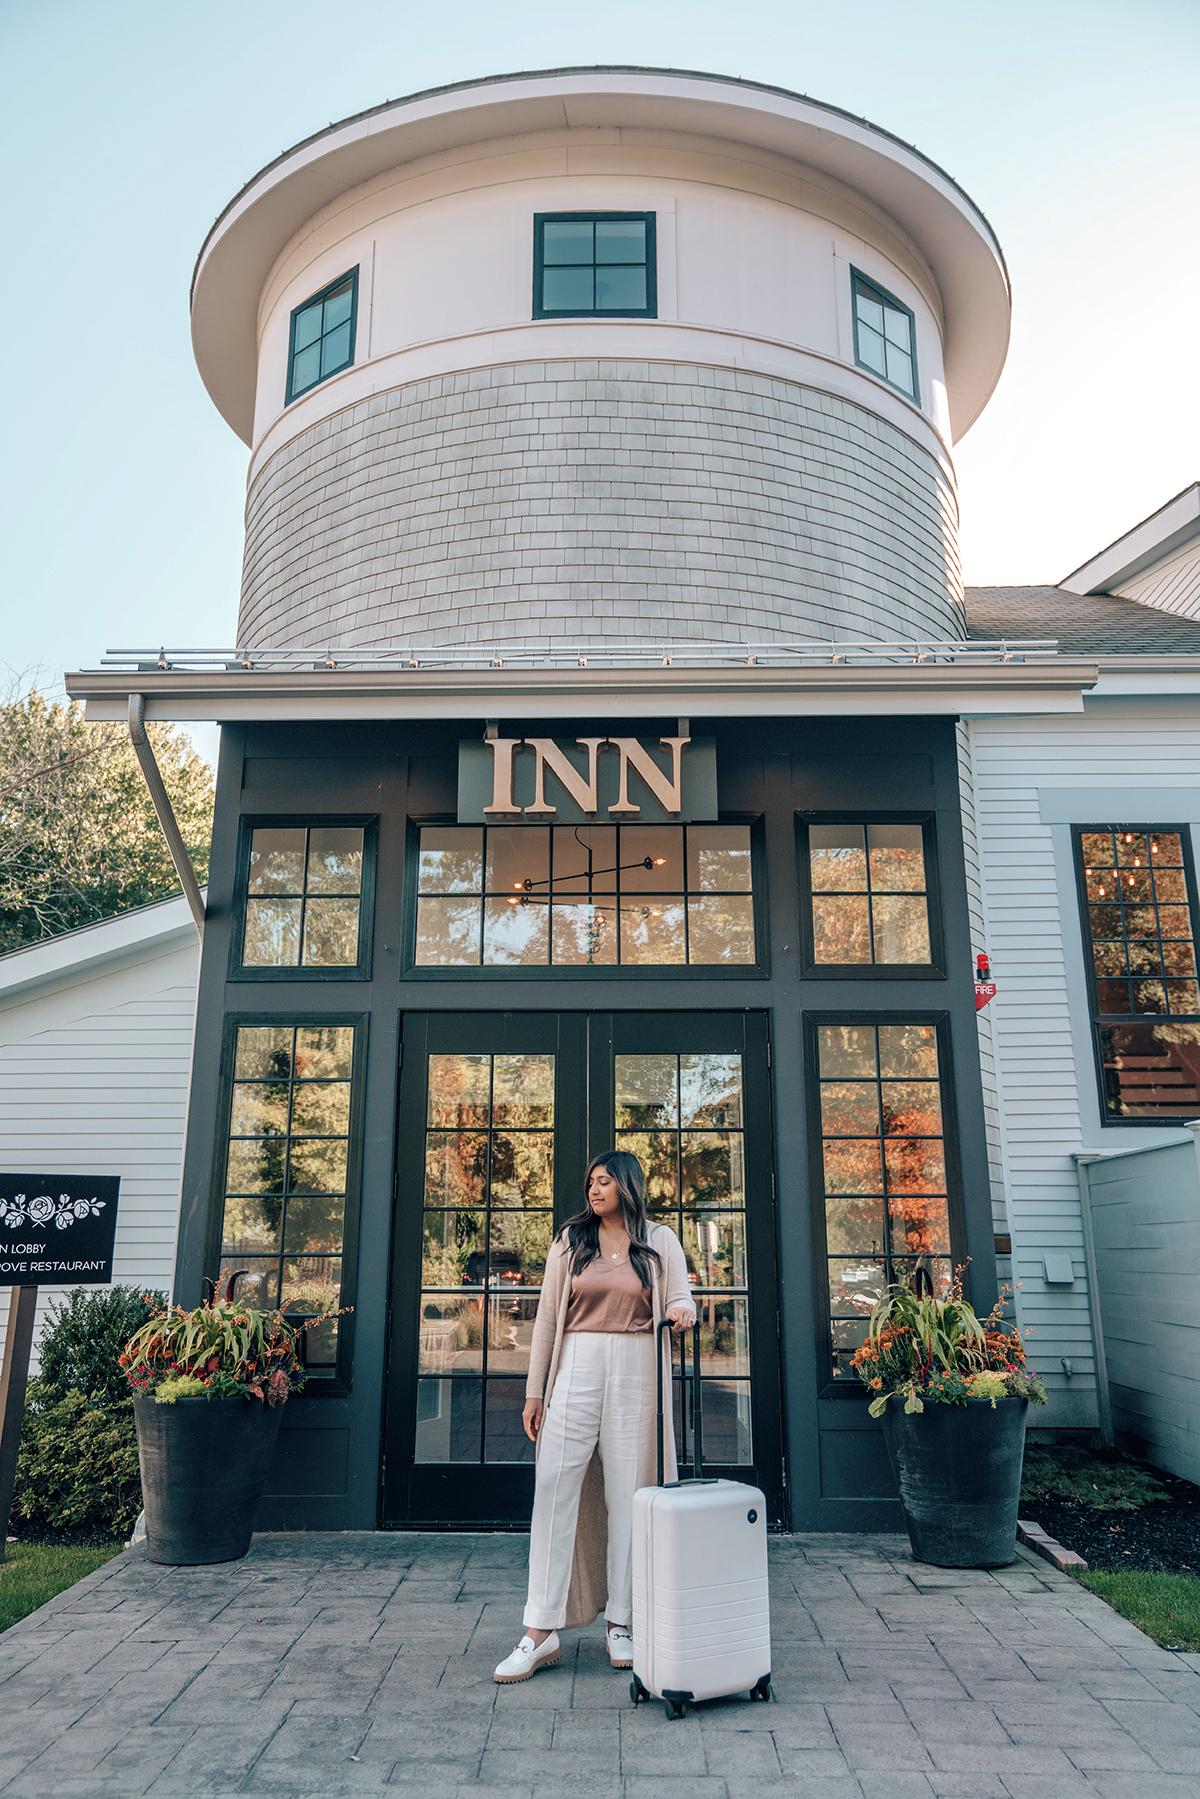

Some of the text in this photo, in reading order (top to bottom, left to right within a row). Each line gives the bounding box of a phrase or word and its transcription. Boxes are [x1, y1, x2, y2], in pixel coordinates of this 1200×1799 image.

[483, 737, 691, 813] INN
[975, 985, 993, 994] FIRE
[11, 1243, 46, 1254] LOBBY
[0, 1260, 106, 1272] OVE RESTAURANT
